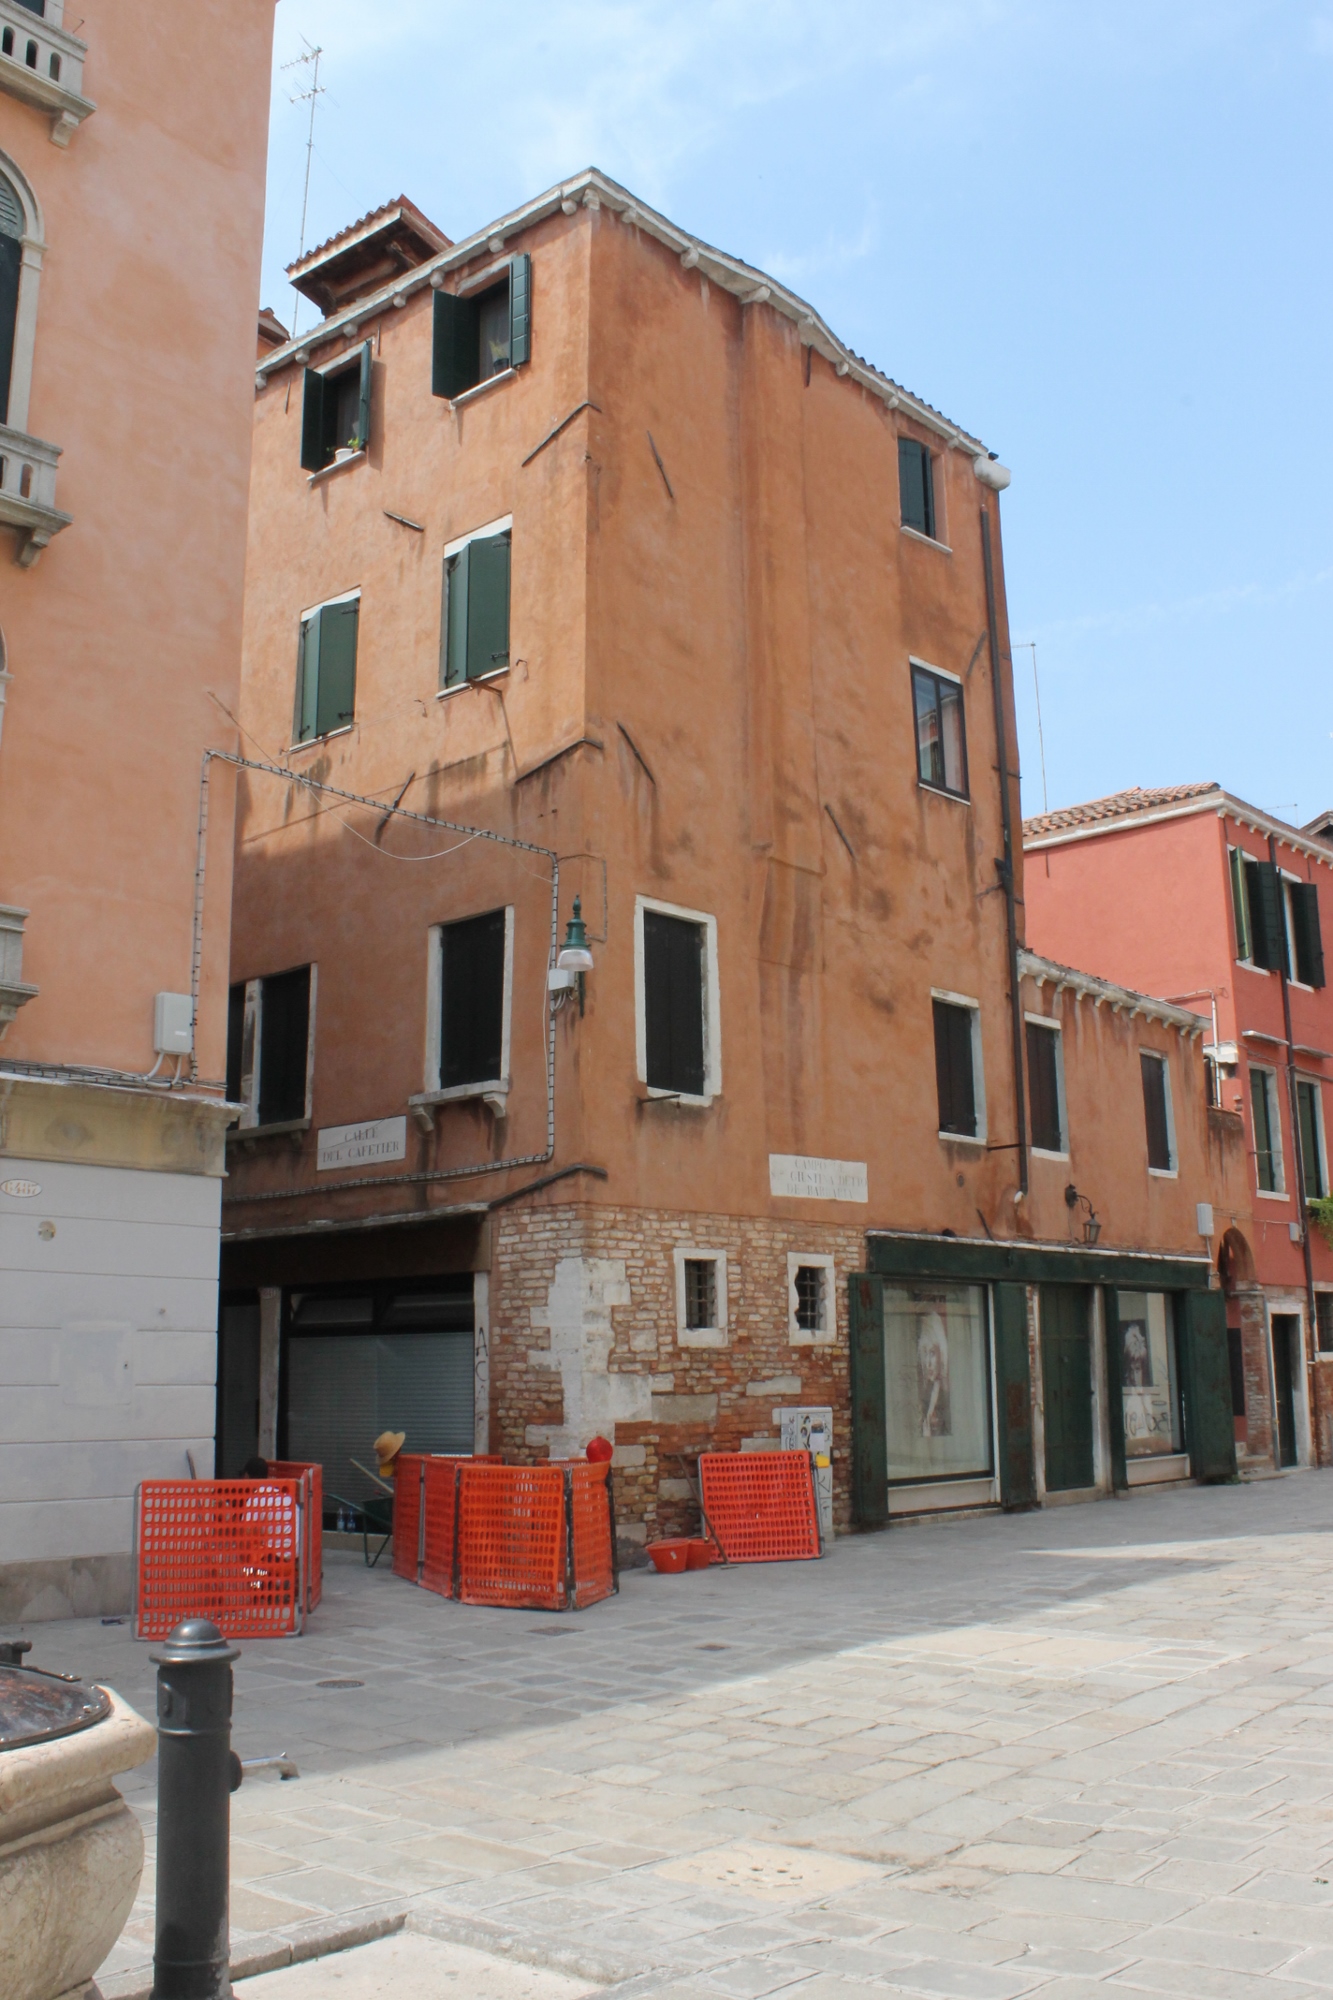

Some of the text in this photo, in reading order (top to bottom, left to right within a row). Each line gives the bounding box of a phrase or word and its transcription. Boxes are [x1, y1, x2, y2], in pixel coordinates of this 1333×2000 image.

[344, 1126, 379, 1143] CALLE
[322, 1140, 399, 1163] DEL CAFETIER
[794, 1158, 827, 1170] CAMPO
